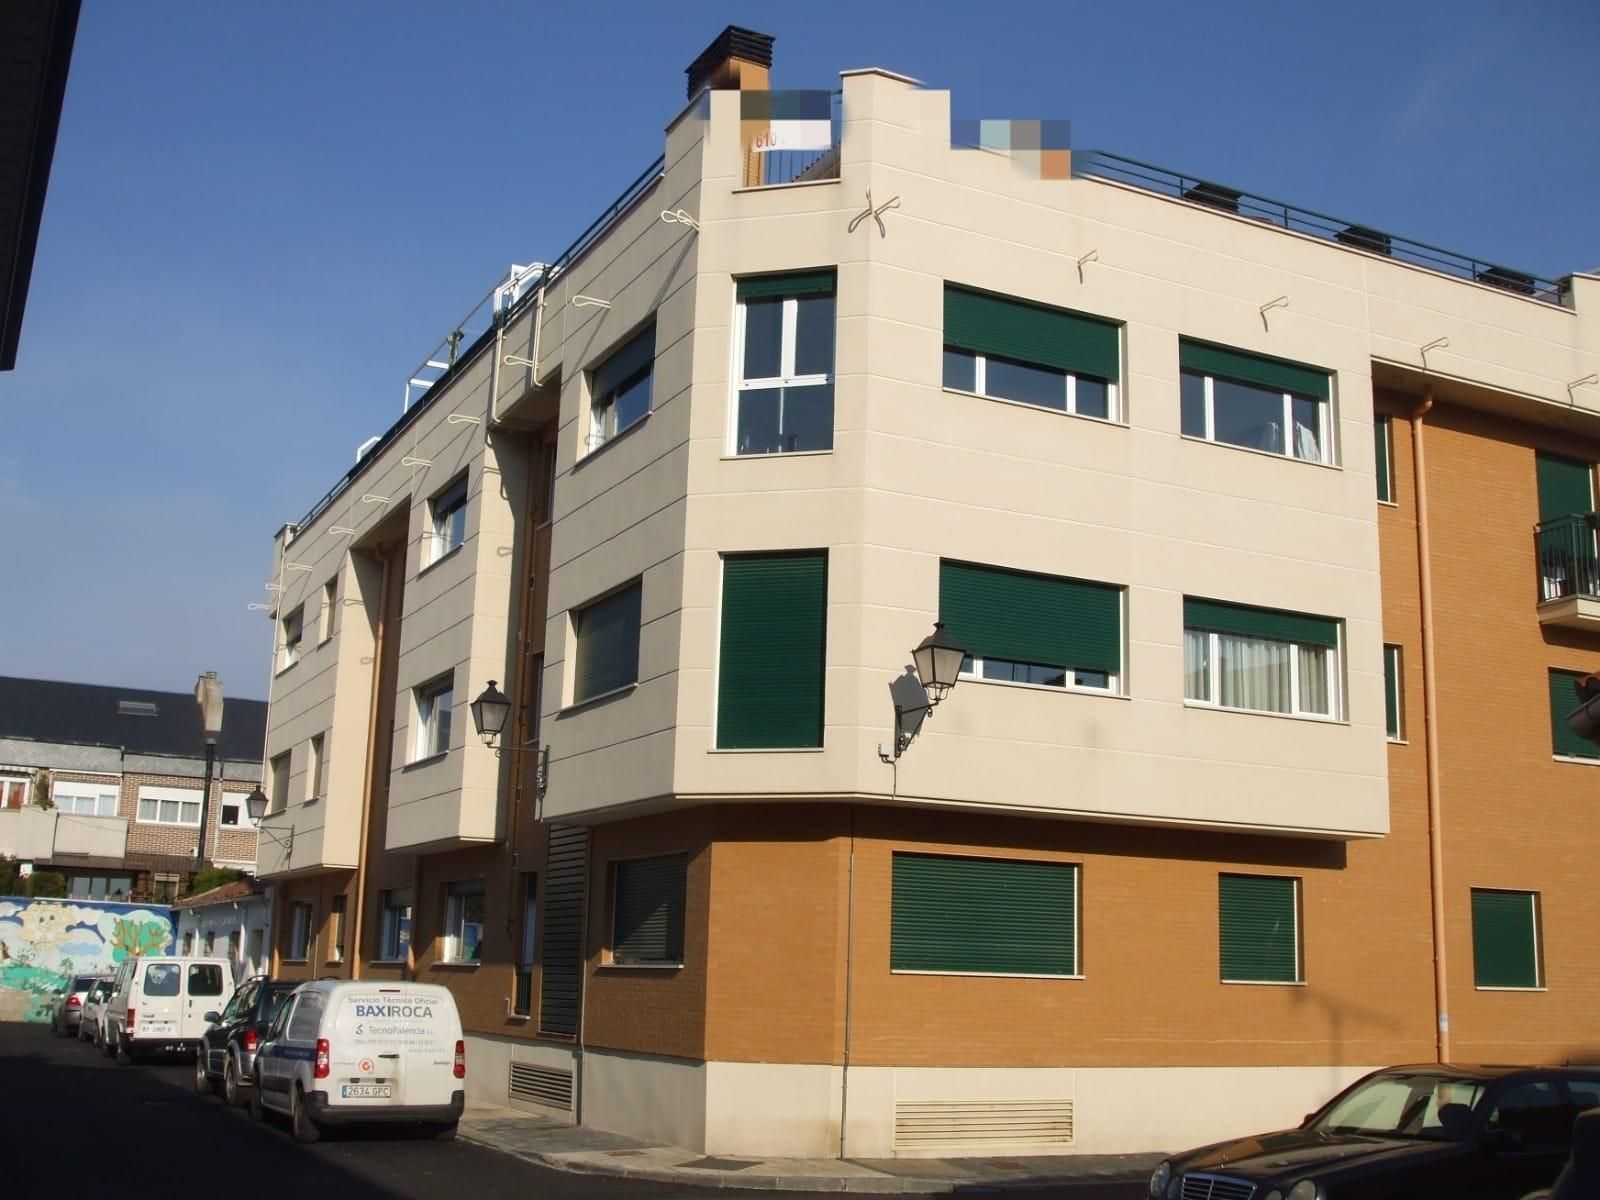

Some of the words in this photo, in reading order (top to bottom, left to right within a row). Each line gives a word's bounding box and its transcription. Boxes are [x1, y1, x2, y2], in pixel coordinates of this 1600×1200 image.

[348, 996, 380, 1004] Servicio
[414, 997, 439, 1005] Oficial
[368, 1025, 425, 1035] TecnoPalencia
